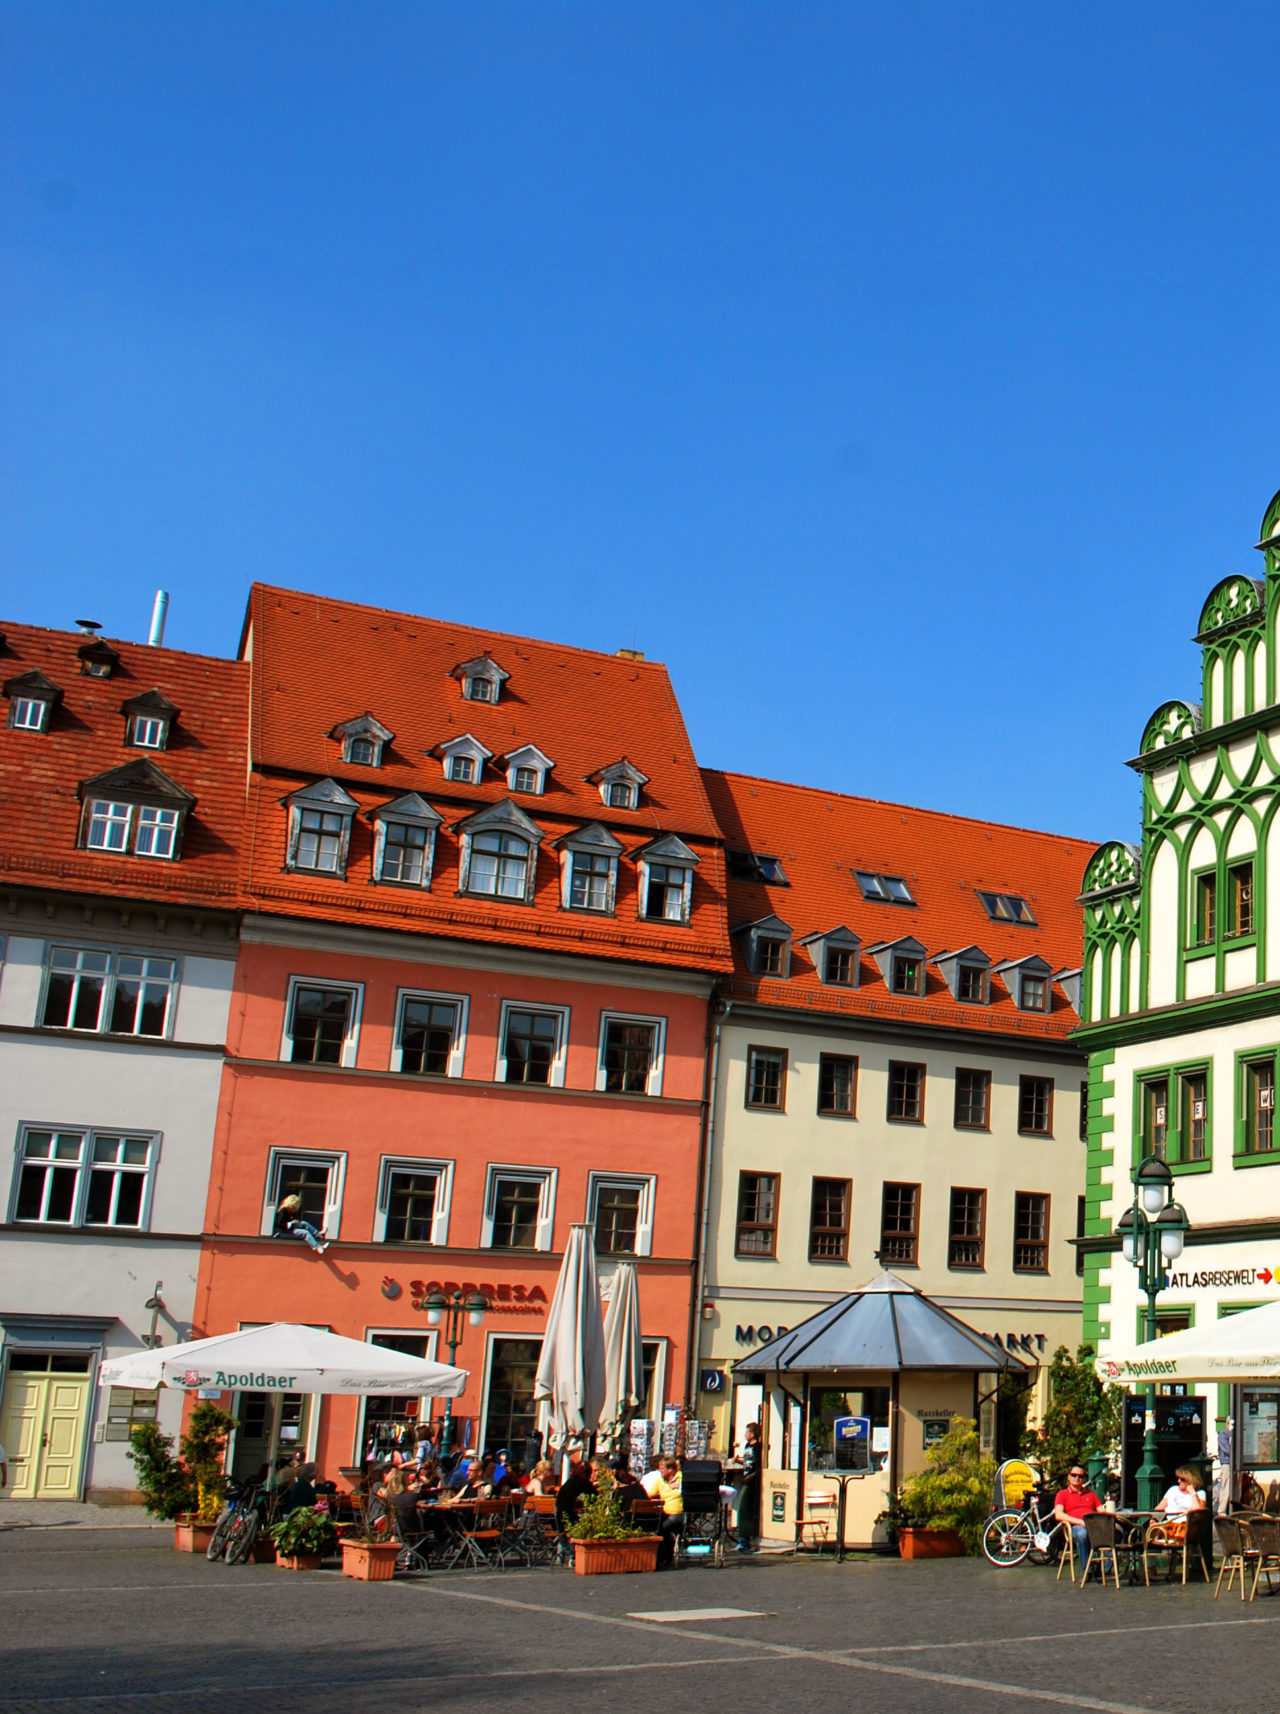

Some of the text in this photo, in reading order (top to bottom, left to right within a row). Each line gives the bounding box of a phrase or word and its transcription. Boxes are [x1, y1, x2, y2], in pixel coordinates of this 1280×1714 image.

[982, 1332, 1046, 1352] ARKT
[1125, 1358, 1177, 1377] Apoldaer
[215, 1371, 297, 1388] Apoldaer
